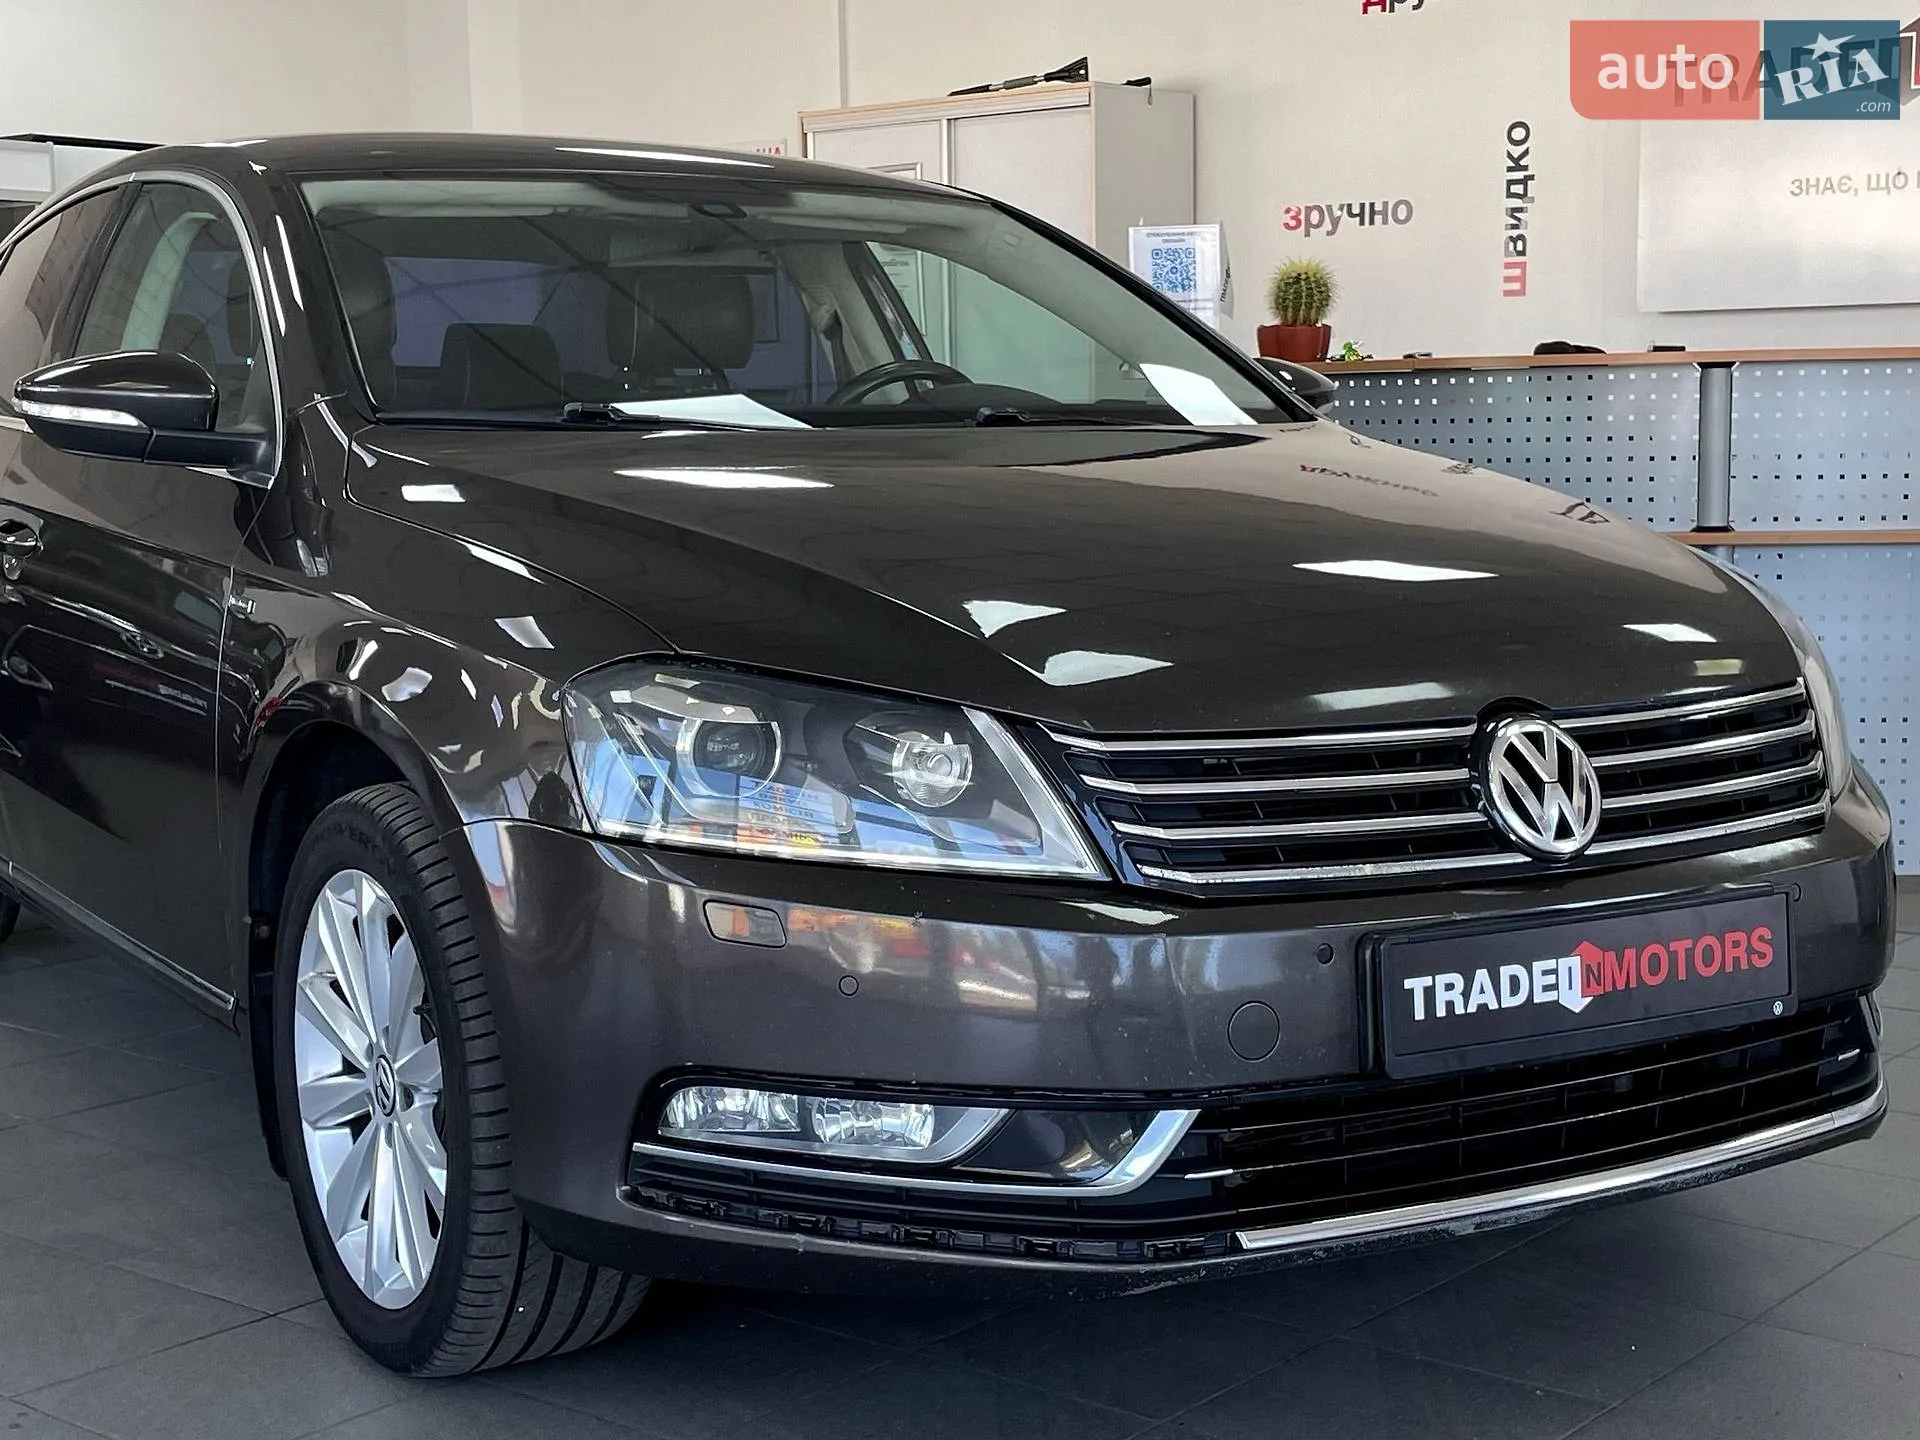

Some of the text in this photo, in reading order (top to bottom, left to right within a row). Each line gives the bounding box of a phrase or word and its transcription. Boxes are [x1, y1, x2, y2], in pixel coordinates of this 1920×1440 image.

[1790, 176, 1858, 197] ЗНАЄ,
[1866, 171, 1909, 195] ЩО
[1283, 199, 1413, 237] зручно
[1503, 121, 1534, 297] швидко
